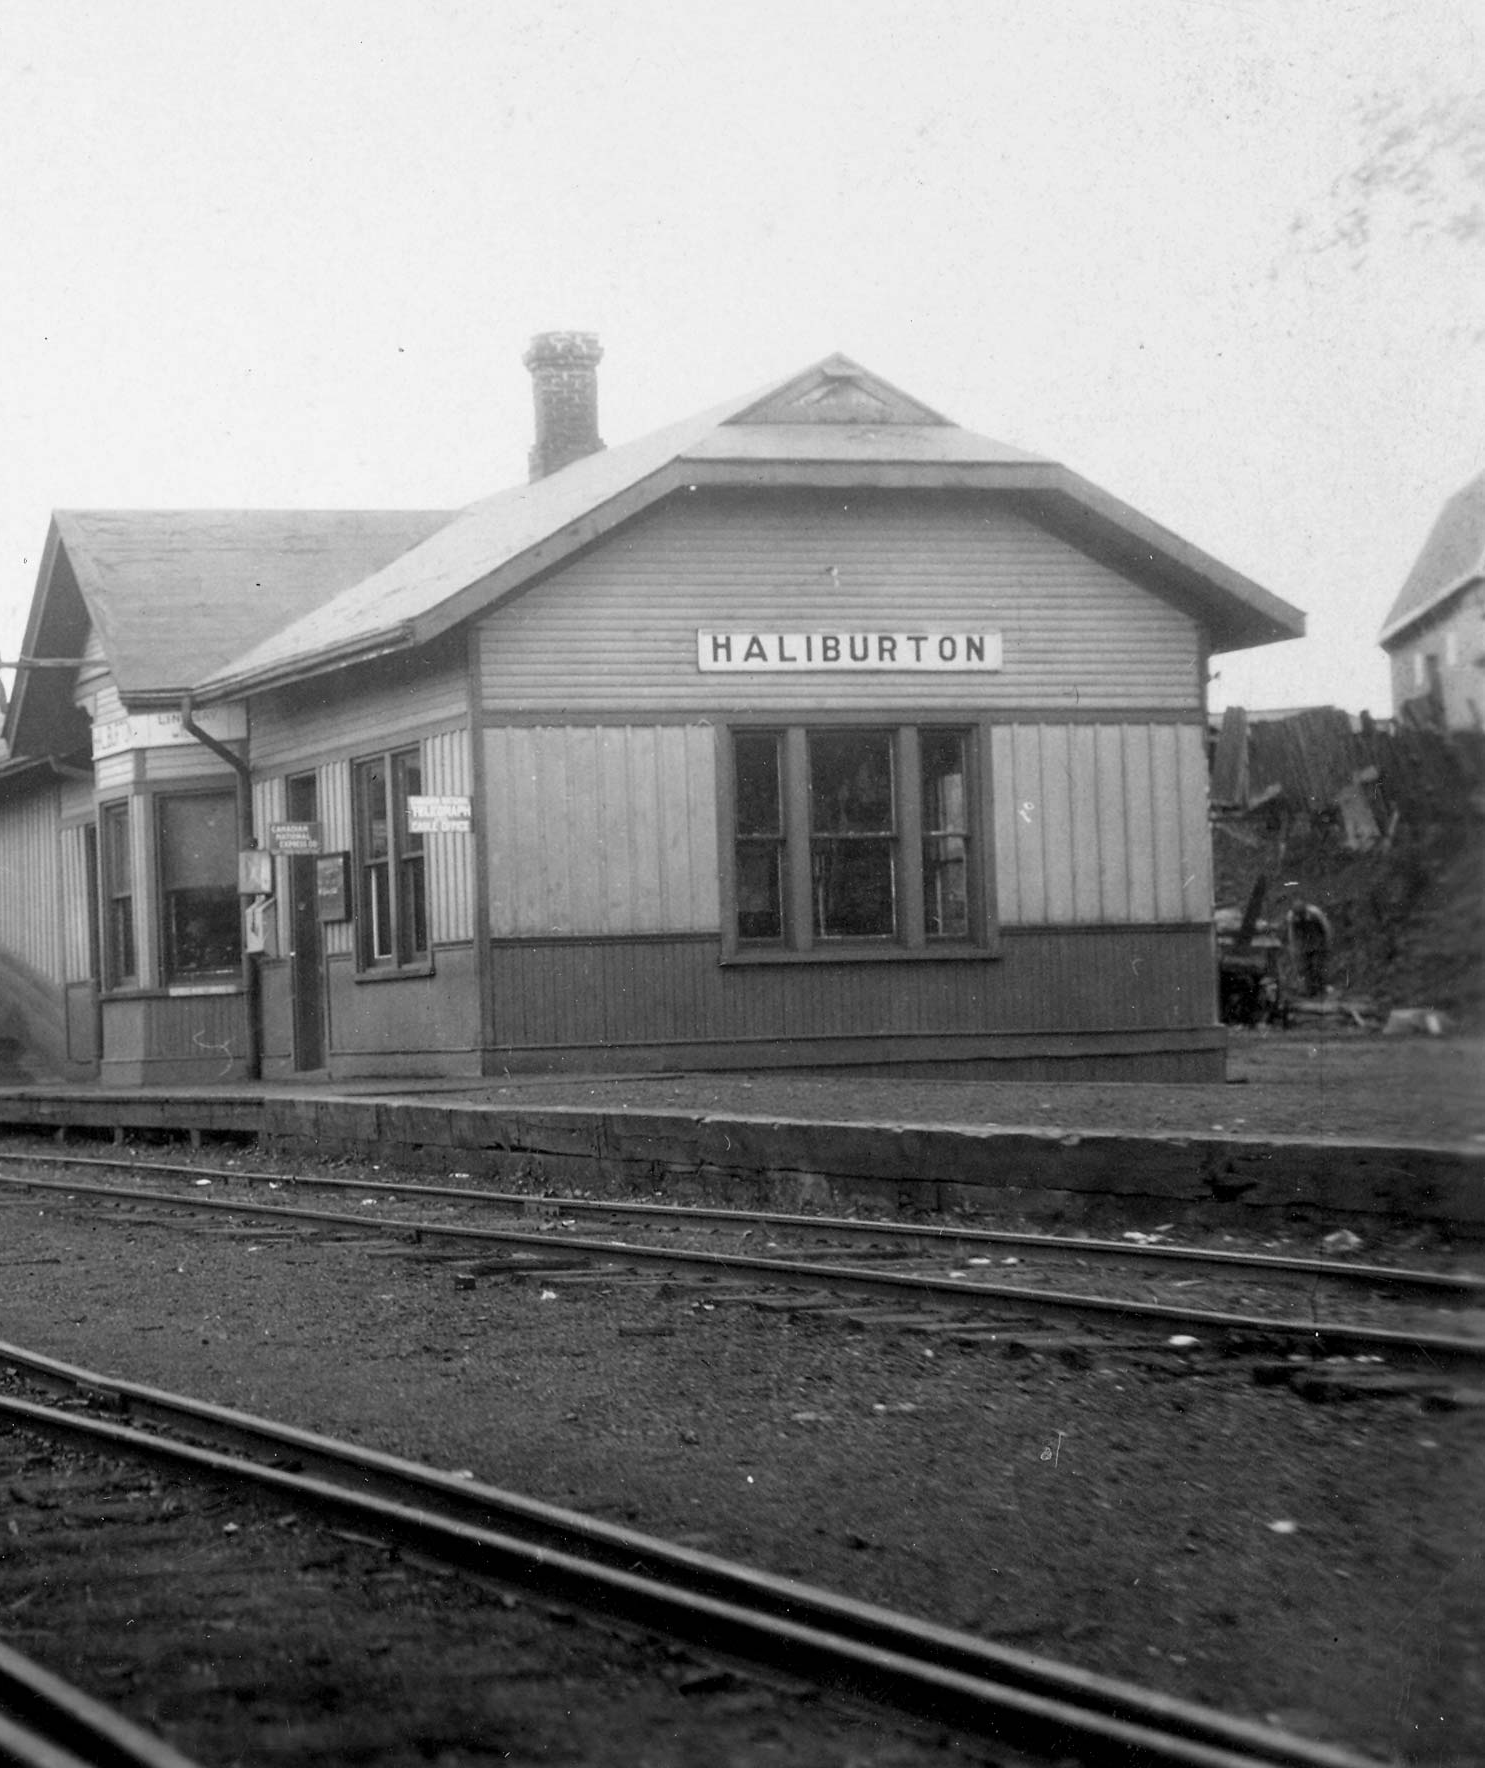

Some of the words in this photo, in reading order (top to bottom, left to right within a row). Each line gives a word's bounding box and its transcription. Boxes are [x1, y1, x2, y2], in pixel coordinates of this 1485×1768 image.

[711, 635, 985, 663] HALIBURTON
[411, 805, 471, 818] TELEGRAPH
[271, 825, 308, 834] CANADIAN
[441, 820, 469, 832] OFFICE
[275, 833, 311, 842] NATIONAL
[279, 840, 308, 849] EXPRESS
